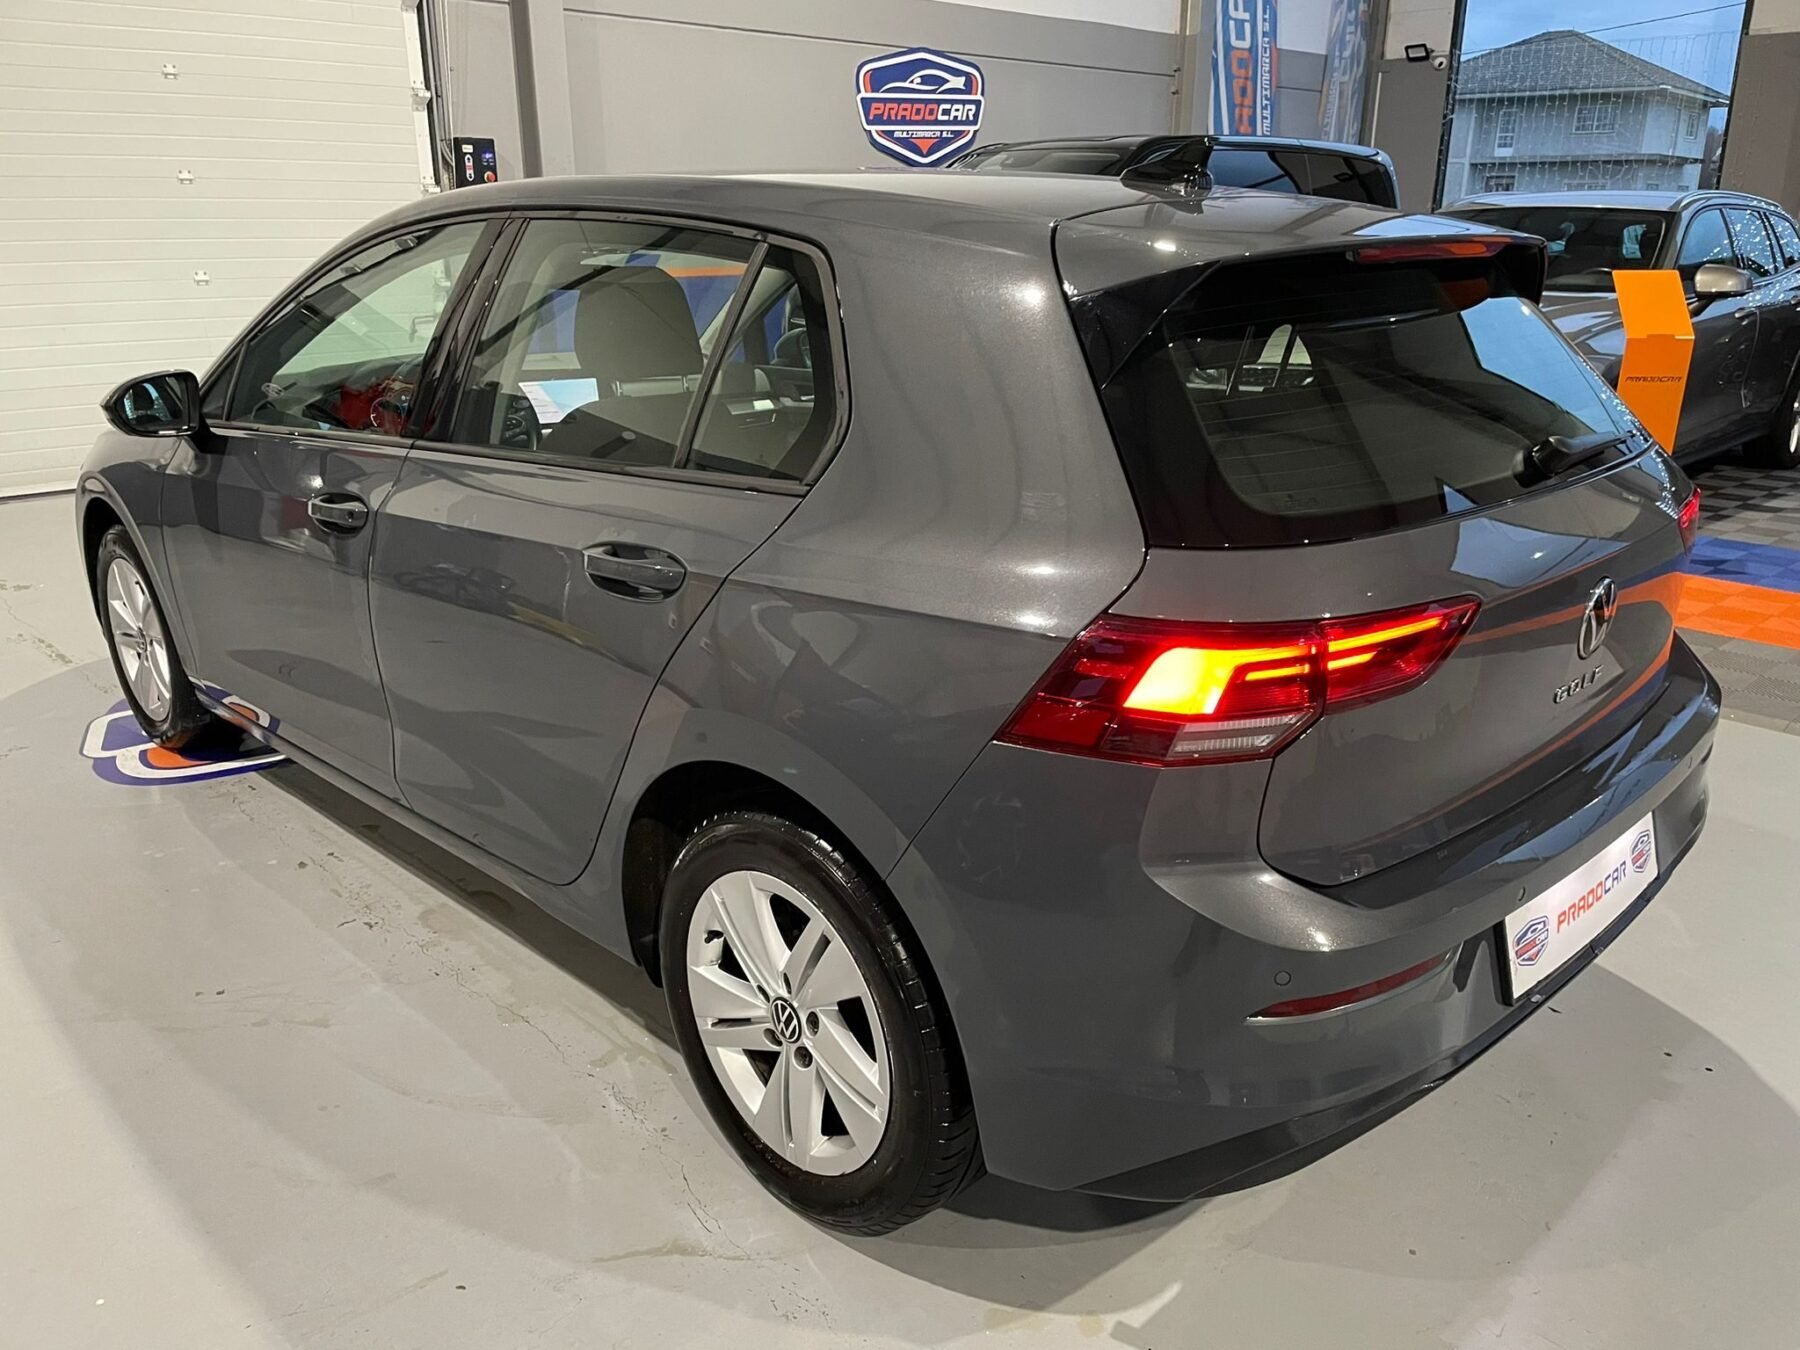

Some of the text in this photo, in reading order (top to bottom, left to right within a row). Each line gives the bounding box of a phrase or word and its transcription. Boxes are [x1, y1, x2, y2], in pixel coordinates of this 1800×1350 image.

[869, 103, 976, 121] PRADOCAR
[1262, 38, 1271, 136] MULTIMARCA
[1553, 664, 1604, 704] GOLF
[1556, 859, 1628, 934] PRADOCAR
